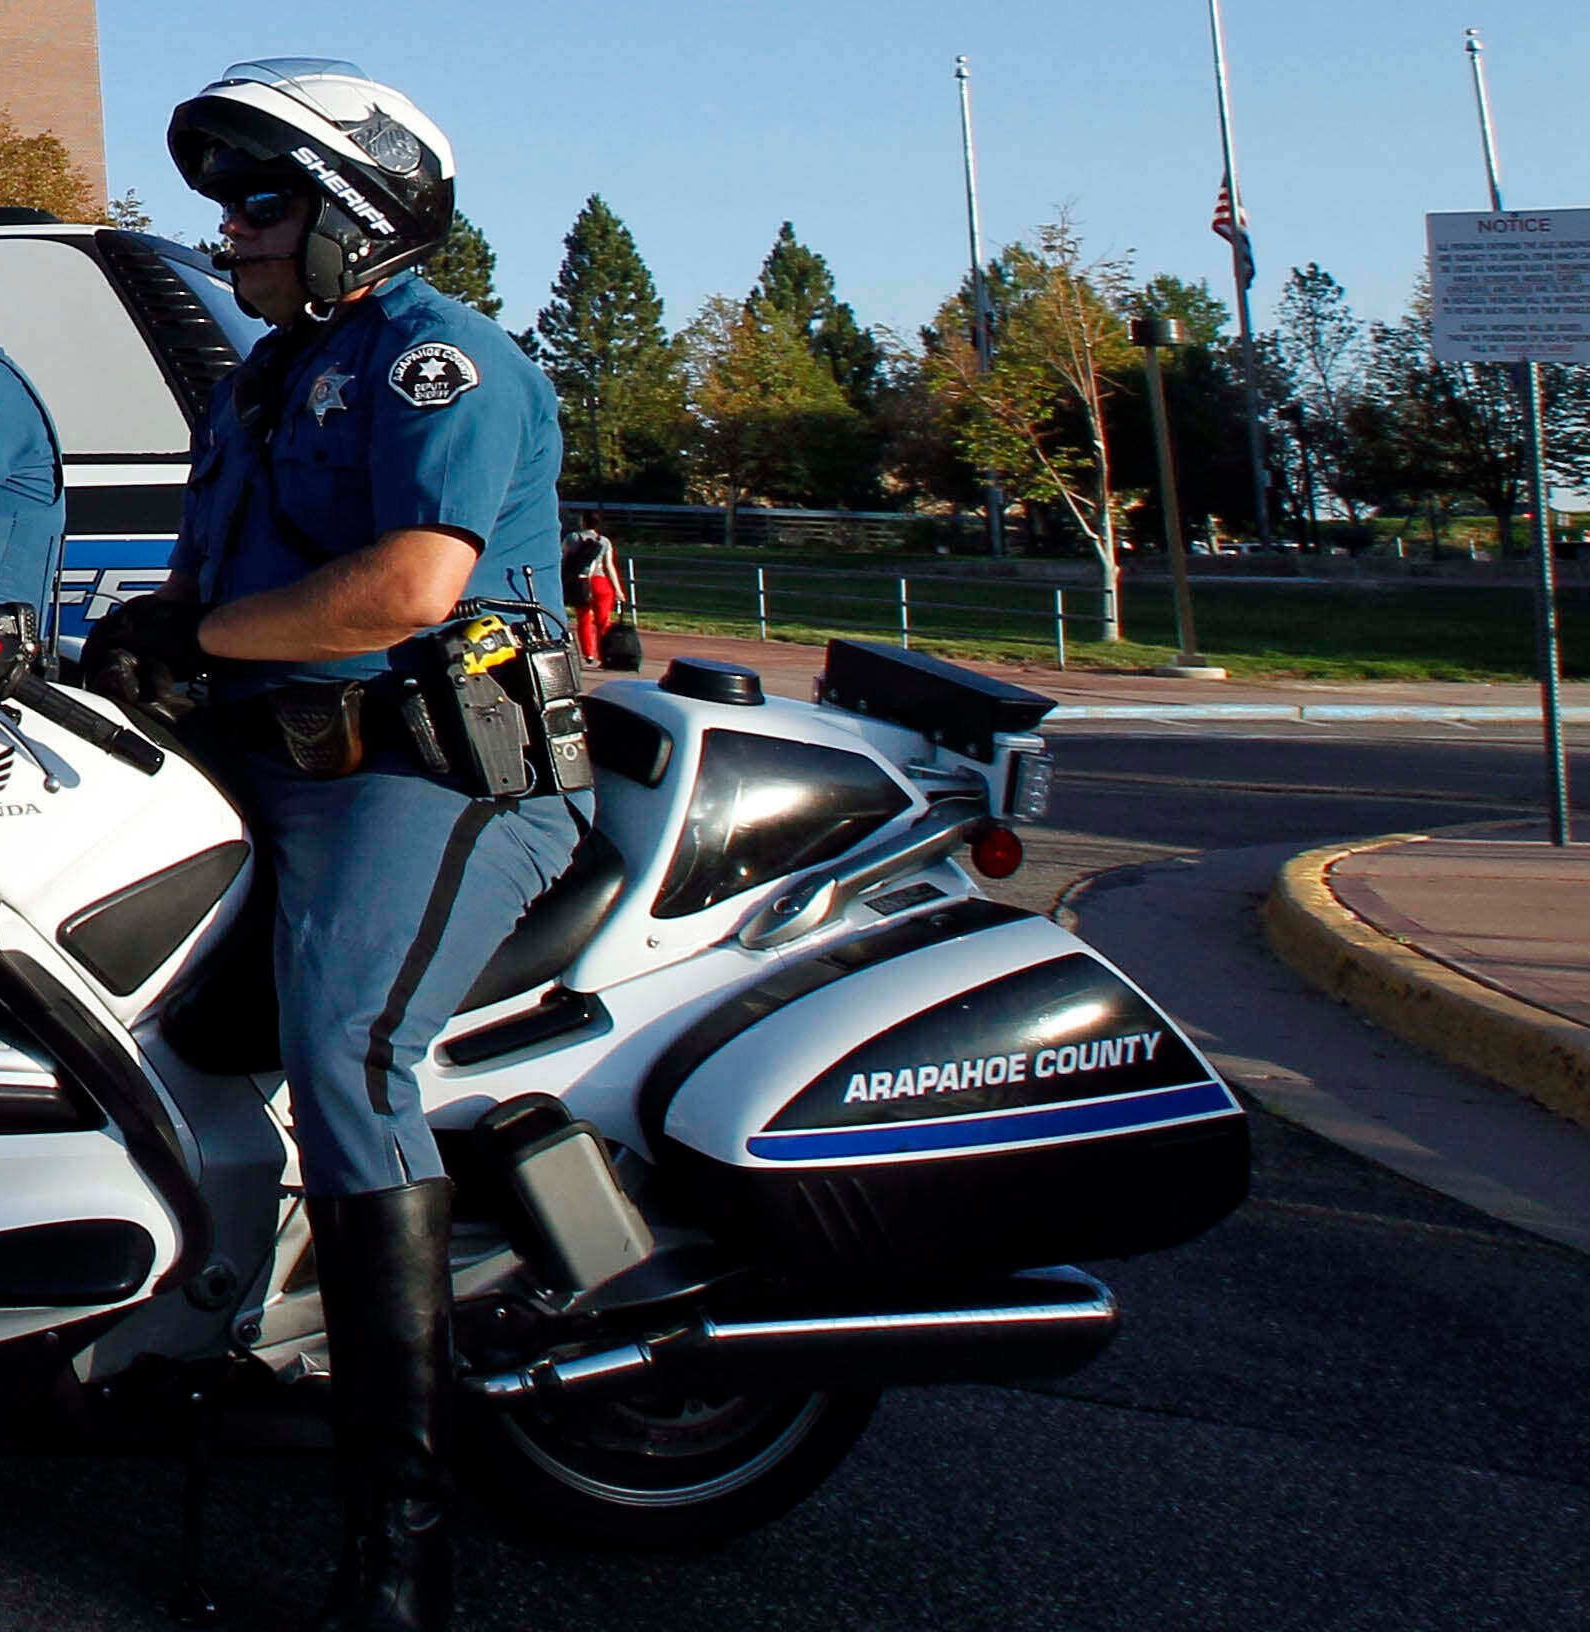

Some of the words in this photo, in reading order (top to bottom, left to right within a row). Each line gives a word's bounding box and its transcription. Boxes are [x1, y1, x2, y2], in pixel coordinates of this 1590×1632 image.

[291, 146, 397, 235] SHERIFF
[1477, 218, 1552, 233] NOTICE
[392, 347, 441, 382] ARAPAHOE
[843, 1053, 1028, 1104] ARAPAHOE
[1034, 1031, 1163, 1079] COUNTY
